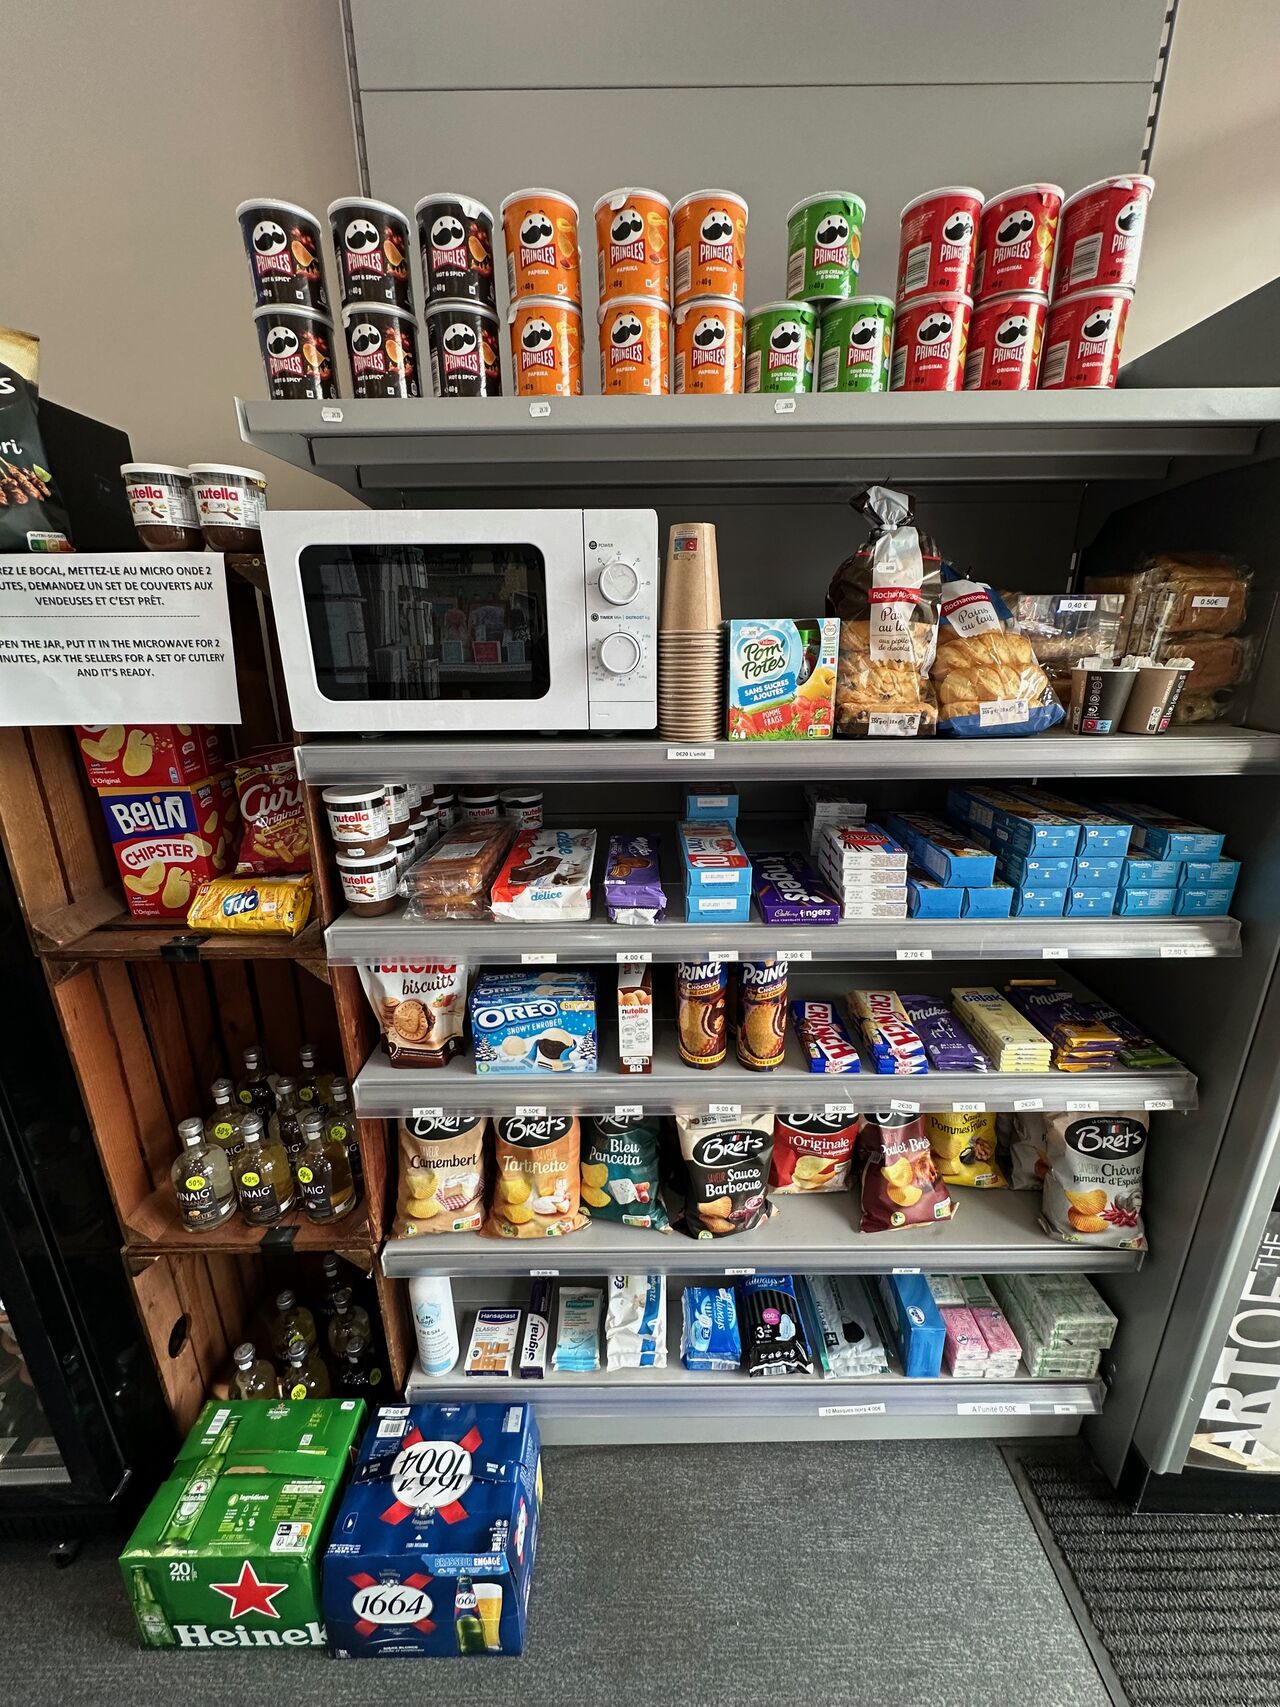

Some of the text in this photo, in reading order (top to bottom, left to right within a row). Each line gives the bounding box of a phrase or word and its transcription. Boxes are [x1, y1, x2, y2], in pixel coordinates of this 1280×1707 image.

[432, 250, 467, 270] PRINGLES
[520, 246, 555, 266] PRINGLES
[610, 242, 645, 263] PRINGLES
[699, 244, 733, 265] PRINGLES
[814, 248, 848, 265] PRINGLES
[992, 239, 1031, 266] PRINGLES
[255, 254, 291, 273] PRINGLES
[347, 252, 383, 273] PRINGLES
[616, 265, 639, 273] PAPRIKA
[996, 264, 1023, 275] ORIGINAL
[521, 350, 554, 369] PRINGLES
[610, 344, 644, 363] PRINGLES
[692, 348, 726, 368] PRINGLES
[914, 342, 950, 363] PRINGLES
[268, 355, 302, 375] PRINGLES
[353, 353, 385, 373] PRINGLES
[444, 354, 478, 374] PRINGLES
[615, 366, 637, 374] PAPRIKA
[197, 487, 239, 501] nutella
[16, 566, 212, 577] LE BOCAL, METTEZ-LE AU MICRO ONDE 2
[28, 581, 213, 591] DEMANDEZ UN SET DE COUVERTS AUX
[35, 595, 165, 606] VENDEUSES ET C'EST PRÊT.
[943, 594, 989, 612] Rochambeau
[958, 607, 989, 624] Pains
[961, 614, 995, 632] au lait
[21, 639, 221, 651] THE JAR, PUT IT IN THE MICROWAVE FOR 2
[42, 653, 225, 663] ASK THE SELLERS FOR A SET OF CUTLERY
[77, 668, 155, 678] AND IT'S READY.
[741, 655, 786, 680] Potes
[744, 678, 790, 697] SANS SUCRES
[753, 687, 784, 702] AJOUTÉS
[762, 708, 782, 719] POMME
[763, 716, 784, 727] FRAISE
[731, 729, 740, 739] 4
[333, 812, 369, 823] nutella
[468, 808, 495, 817] nutella
[125, 844, 194, 866] CHIPSTER
[799, 908, 832, 918] fingers
[677, 961, 722, 981] PRINCE
[401, 974, 456, 997] biscuits
[477, 1003, 558, 1029] OREO
[621, 1007, 649, 1015] nutella
[907, 1006, 951, 1022] Milka
[507, 1018, 563, 1036] SNOWY ENROBED
[869, 994, 921, 1046] CRUNCH
[807, 1003, 856, 1061] CRUNCH
[506, 1117, 566, 1143] Brets
[931, 1117, 970, 1135] Pommes
[610, 1138, 640, 1154] Bleu
[789, 1135, 850, 1150] l'Originale
[1076, 1126, 1142, 1153] Brets
[590, 1146, 643, 1166] Pancetta
[702, 1136, 764, 1164] Brets
[410, 1154, 477, 1170] Camembert
[503, 1155, 568, 1174] Tartiflette
[1100, 1163, 1141, 1177] Chèvre
[188, 1179, 204, 1187] 50%
[244, 1175, 258, 1184] 50%
[727, 1168, 761, 1182] Sauce
[1073, 1174, 1106, 1185] piment
[705, 1179, 763, 1198] Barbecue
[746, 1275, 778, 1287] always
[419, 1329, 441, 1337] FRESH
[528, 1319, 539, 1361] Signal
[756, 1326, 765, 1339] 3
[832, 1406, 854, 1414] Masques
[169, 1561, 191, 1577] 20
[434, 1556, 501, 1567] BRASSEUR ENGAGÉ
[359, 1590, 426, 1616] 1664
